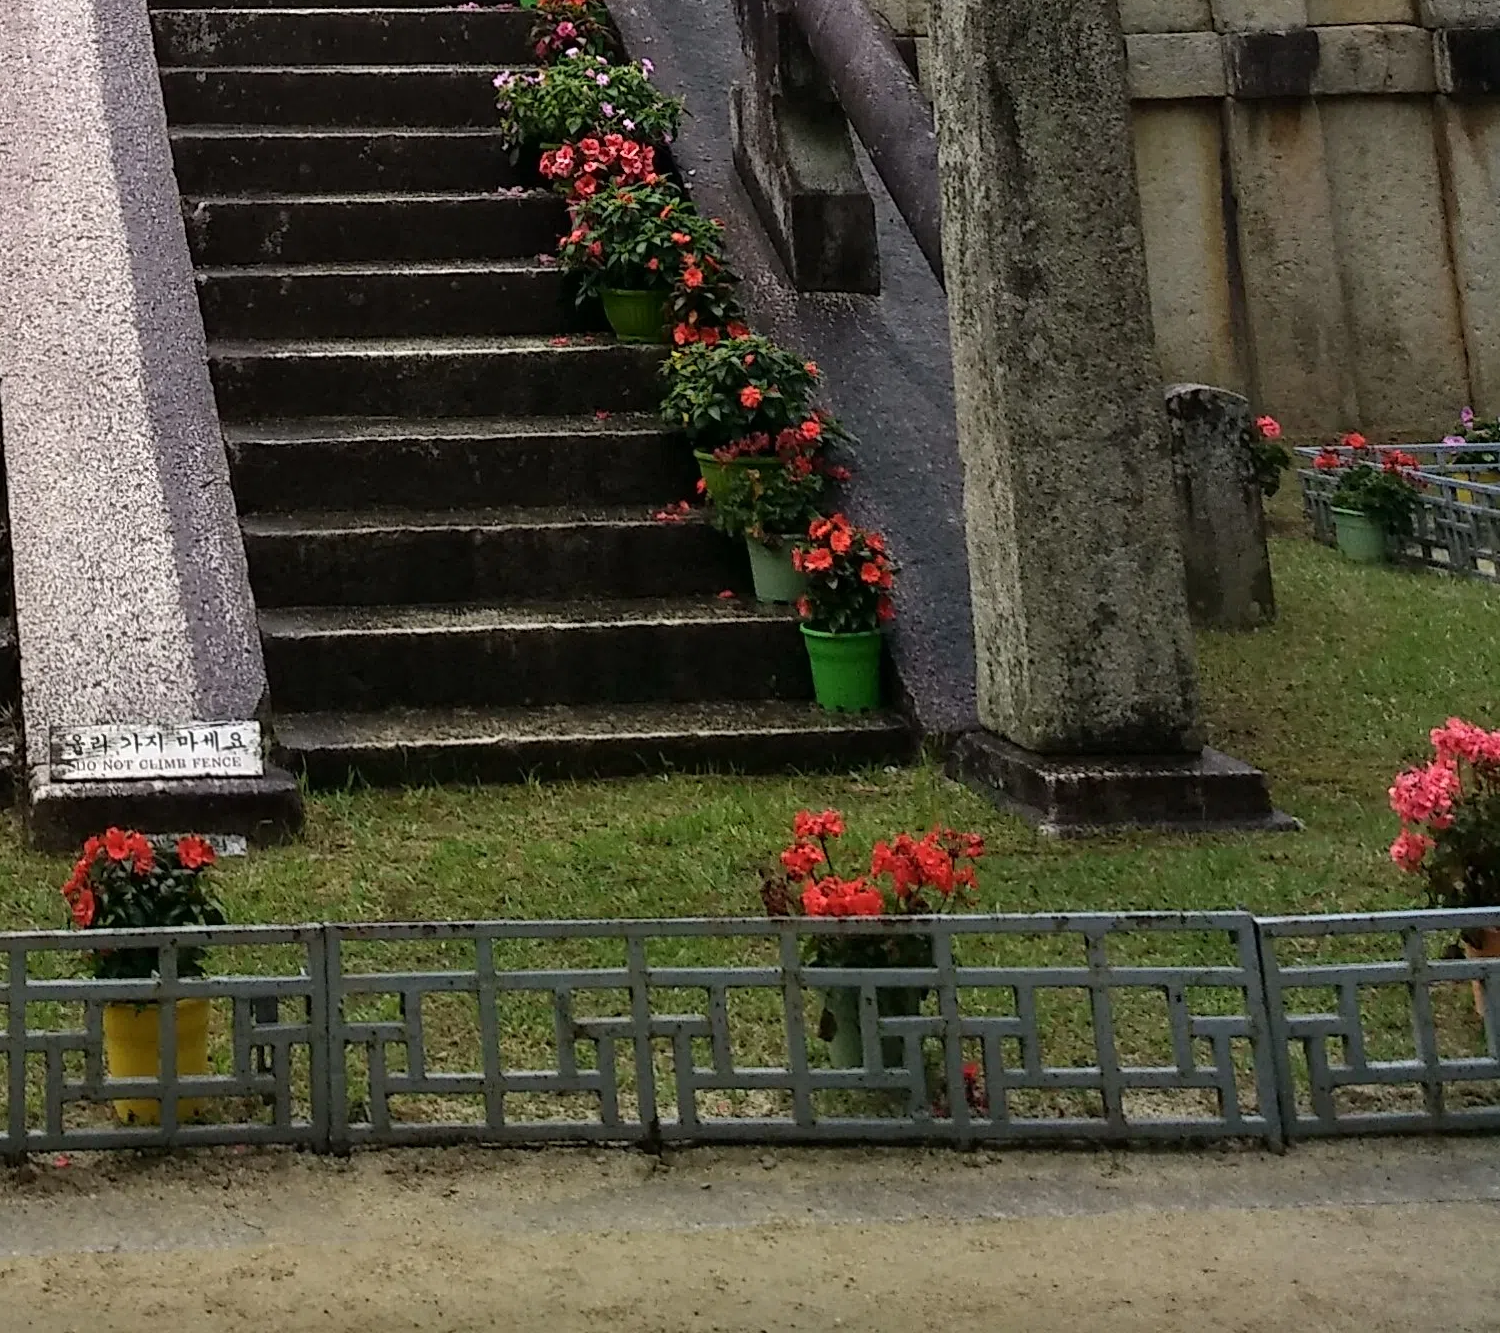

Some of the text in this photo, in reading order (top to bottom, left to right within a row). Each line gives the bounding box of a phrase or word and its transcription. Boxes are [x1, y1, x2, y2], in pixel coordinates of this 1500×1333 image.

[120, 732, 164, 754] 가지
[176, 731, 246, 752] 마세요
[76, 756, 242, 772] DO NOT CLIMB FENCE
